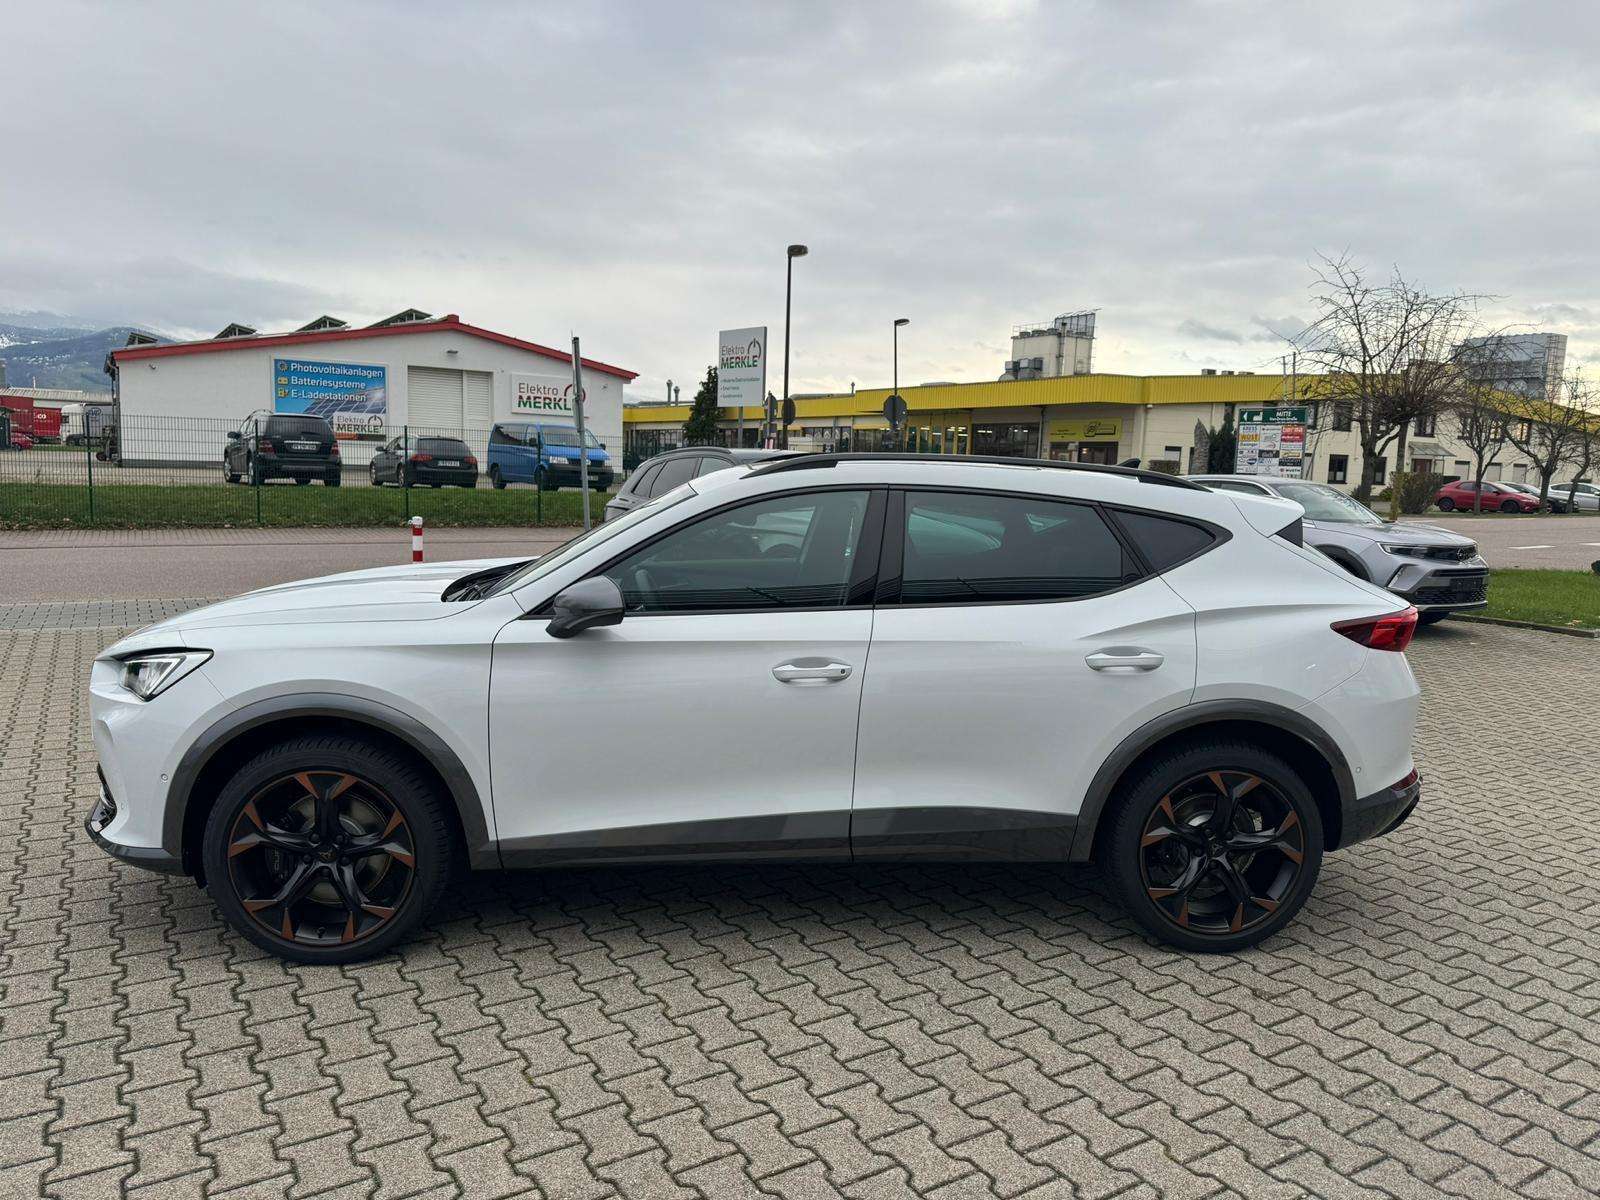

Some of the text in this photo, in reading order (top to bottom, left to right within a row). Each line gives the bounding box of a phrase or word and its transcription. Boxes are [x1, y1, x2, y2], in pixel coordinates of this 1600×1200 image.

[721, 345, 745, 356] Elektro
[720, 354, 758, 370] MERKLE
[290, 362, 383, 378] Photovoltaikanlagen
[291, 376, 366, 389] Batteriesysteme
[518, 382, 559, 396] Elektro
[291, 389, 367, 402] E-Ladestationen
[517, 395, 573, 411] MERKL
[337, 415, 365, 424] Elektro
[336, 423, 379, 433] MERKLE
